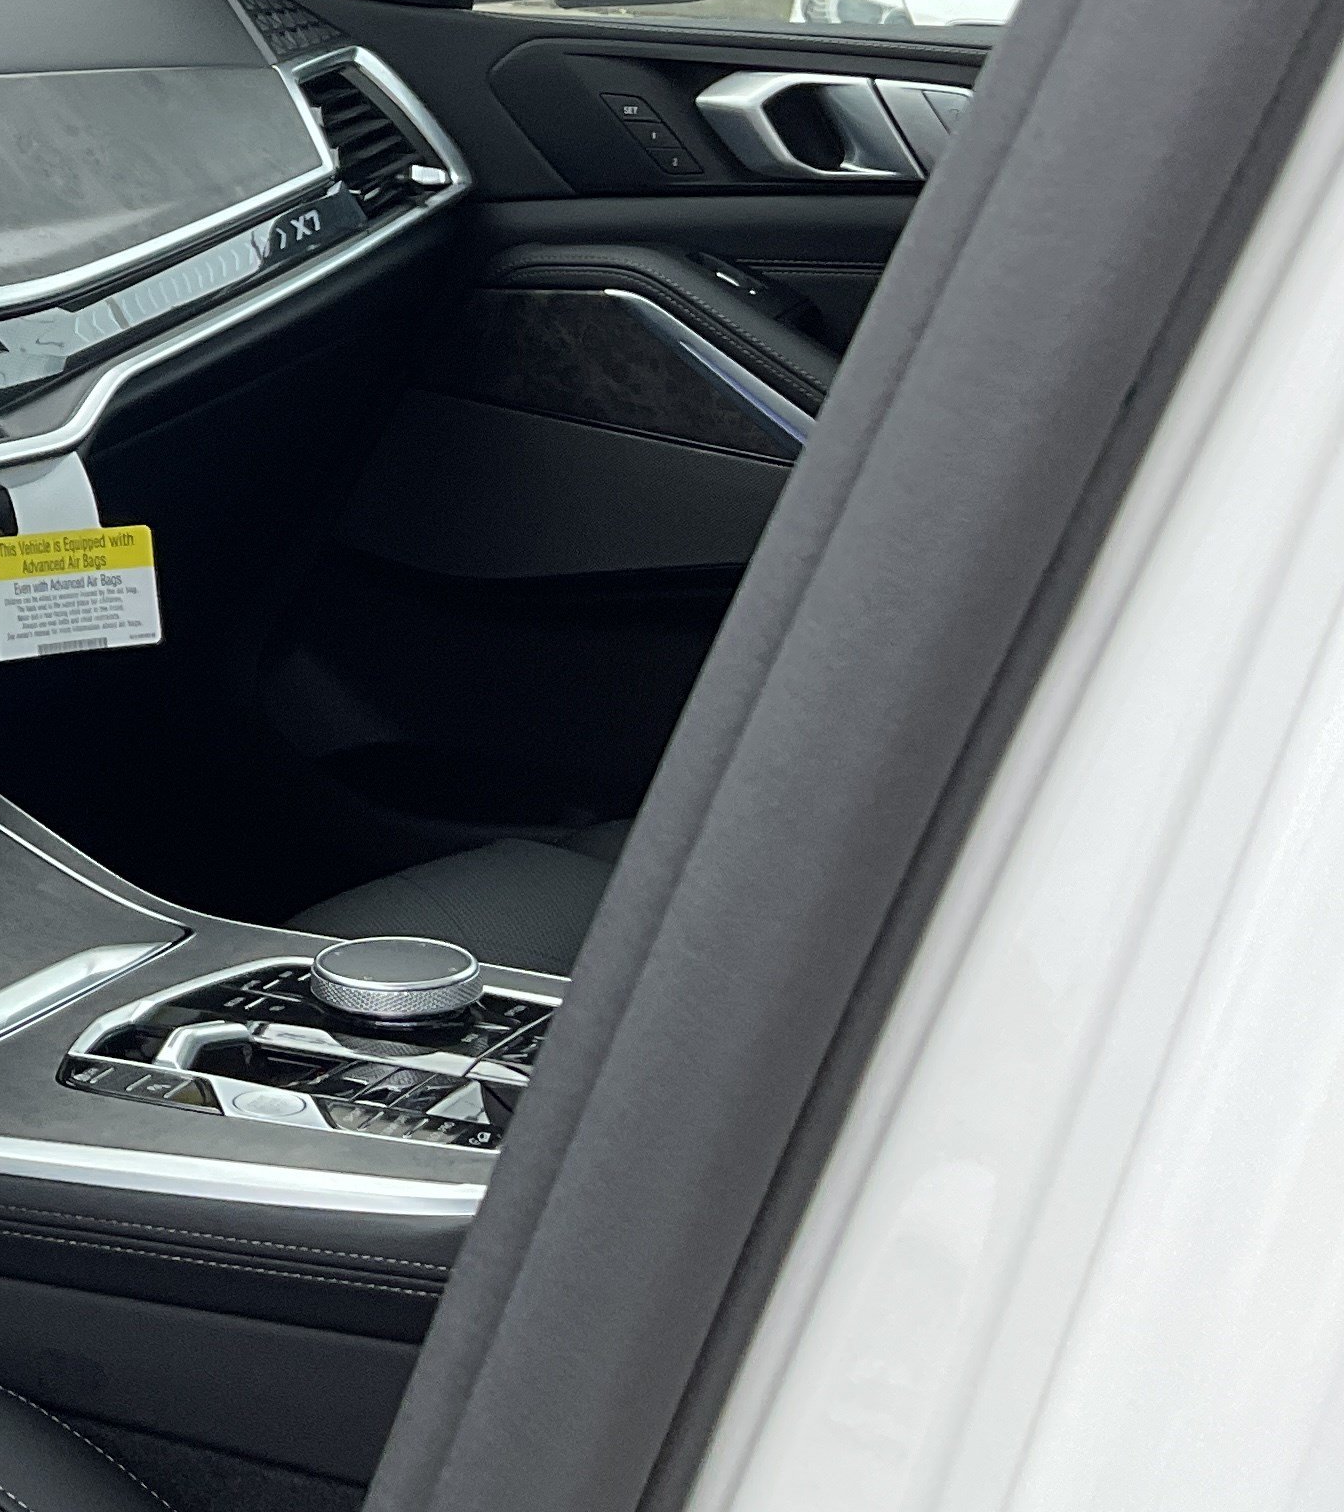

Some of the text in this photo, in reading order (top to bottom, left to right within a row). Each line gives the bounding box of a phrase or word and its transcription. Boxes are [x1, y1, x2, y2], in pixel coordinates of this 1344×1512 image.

[624, 107, 638, 115] SET
[290, 209, 321, 241] X7
[18, 538, 51, 556] Vehicle
[63, 534, 106, 552] Equipped
[108, 532, 135, 547] with
[22, 553, 108, 575] Advanced Air Bags
[14, 581, 32, 596] Even
[50, 575, 86, 591] Advanced
[99, 573, 123, 589] Bags
